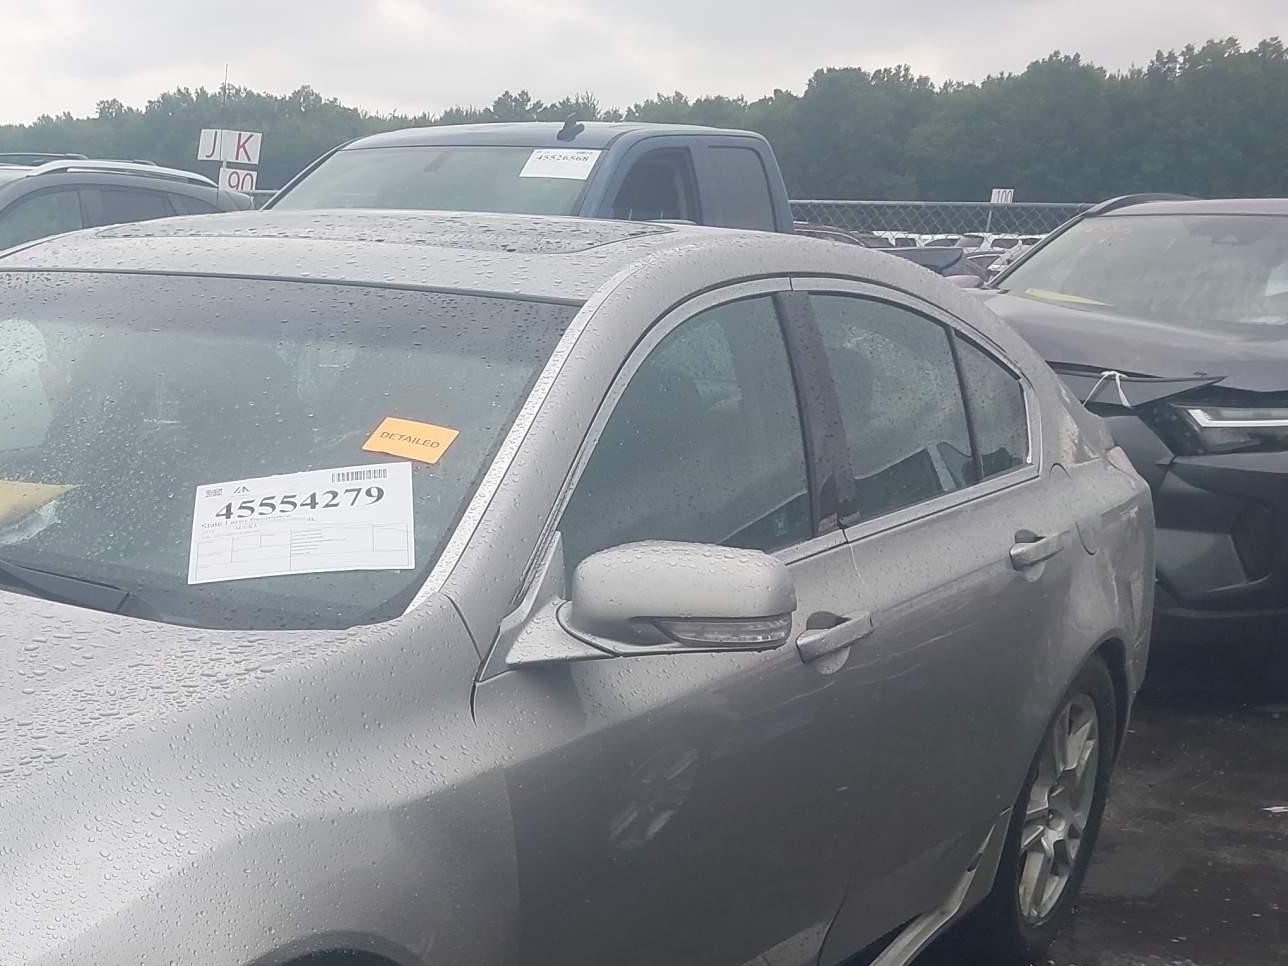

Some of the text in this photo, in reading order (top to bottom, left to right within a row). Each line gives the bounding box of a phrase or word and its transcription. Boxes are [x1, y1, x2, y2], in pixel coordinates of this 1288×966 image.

[205, 131, 254, 161] J K
[227, 170, 254, 190] 90
[380, 431, 440, 449] DETAILED
[215, 486, 385, 520] 45554279
